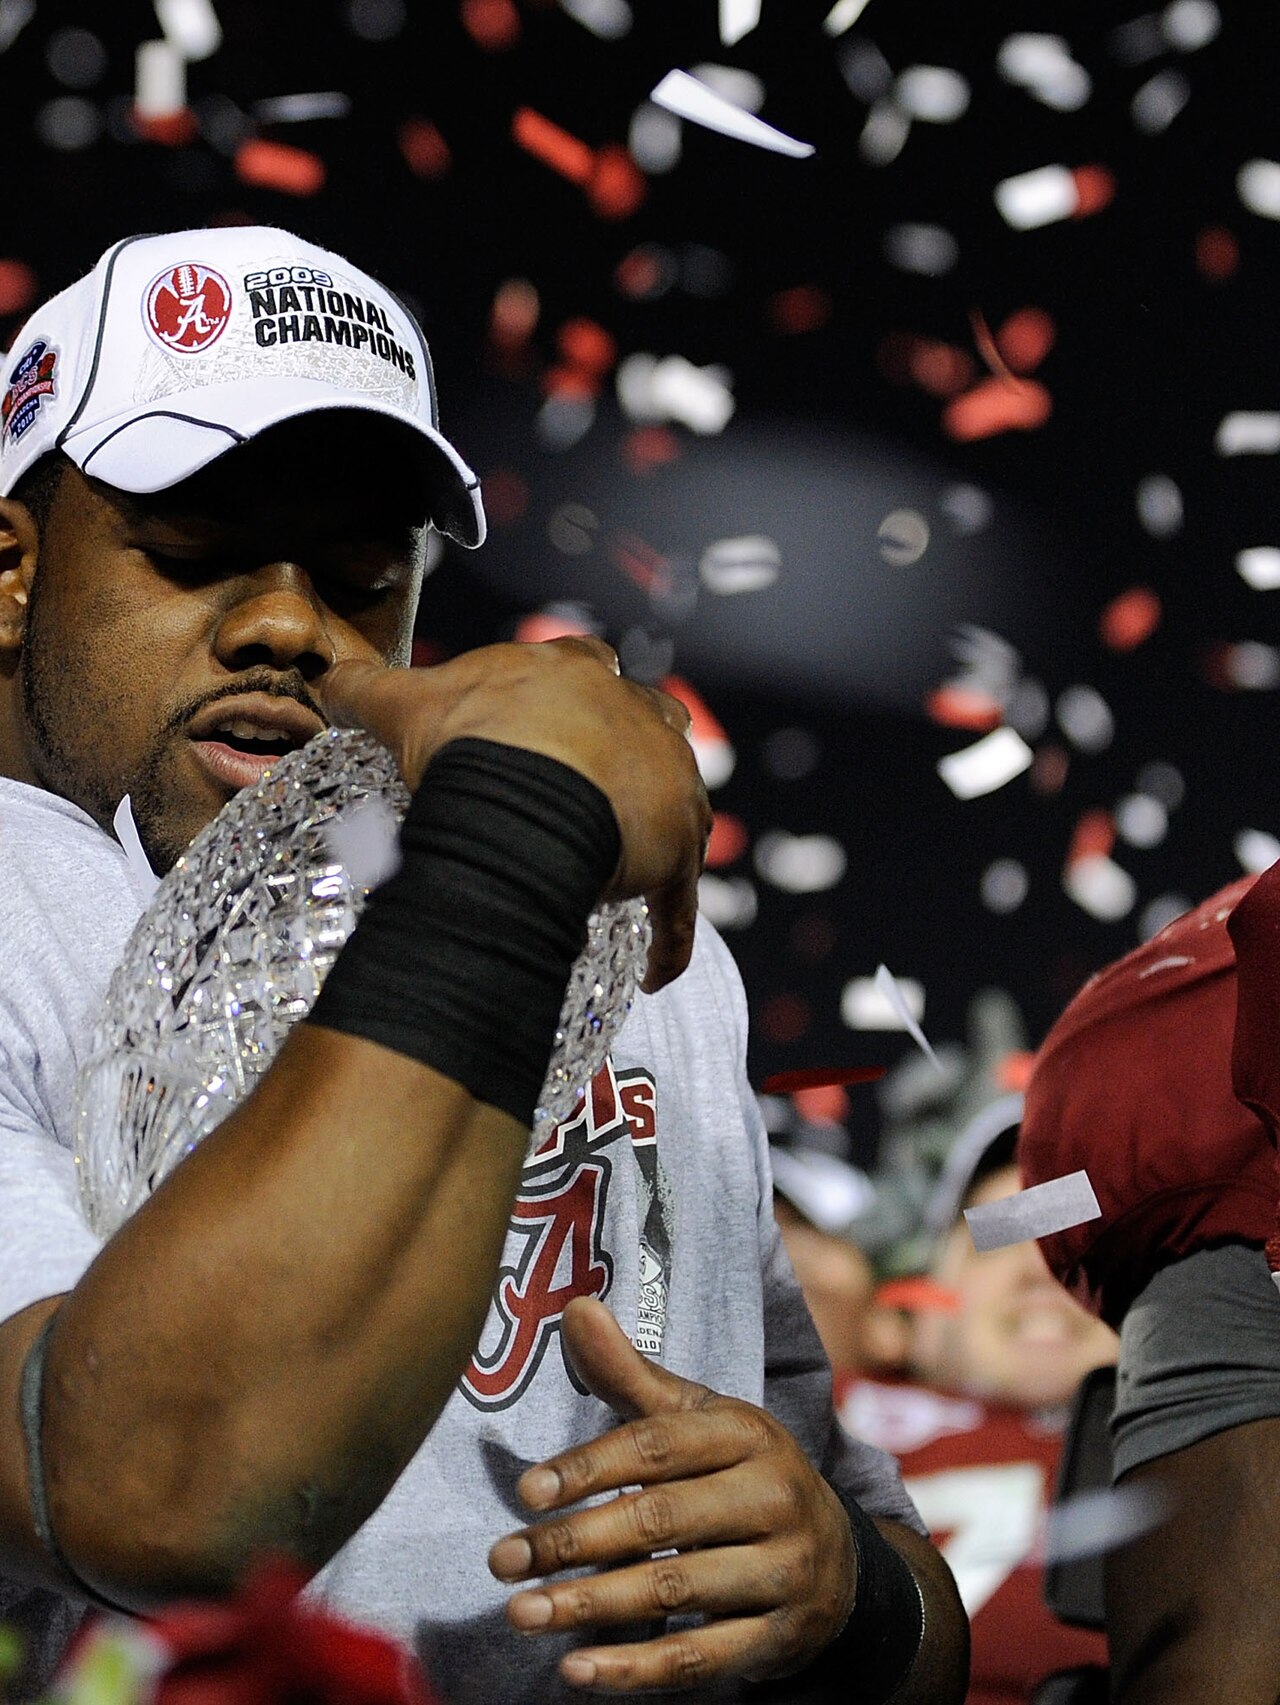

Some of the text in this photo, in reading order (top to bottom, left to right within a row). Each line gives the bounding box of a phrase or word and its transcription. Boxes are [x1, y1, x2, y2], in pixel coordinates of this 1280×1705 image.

[244, 266, 333, 292] 2009
[249, 286, 394, 336] NATIONAL
[254, 314, 416, 381] CHAMPIONS
[16, 411, 33, 433] 2010
